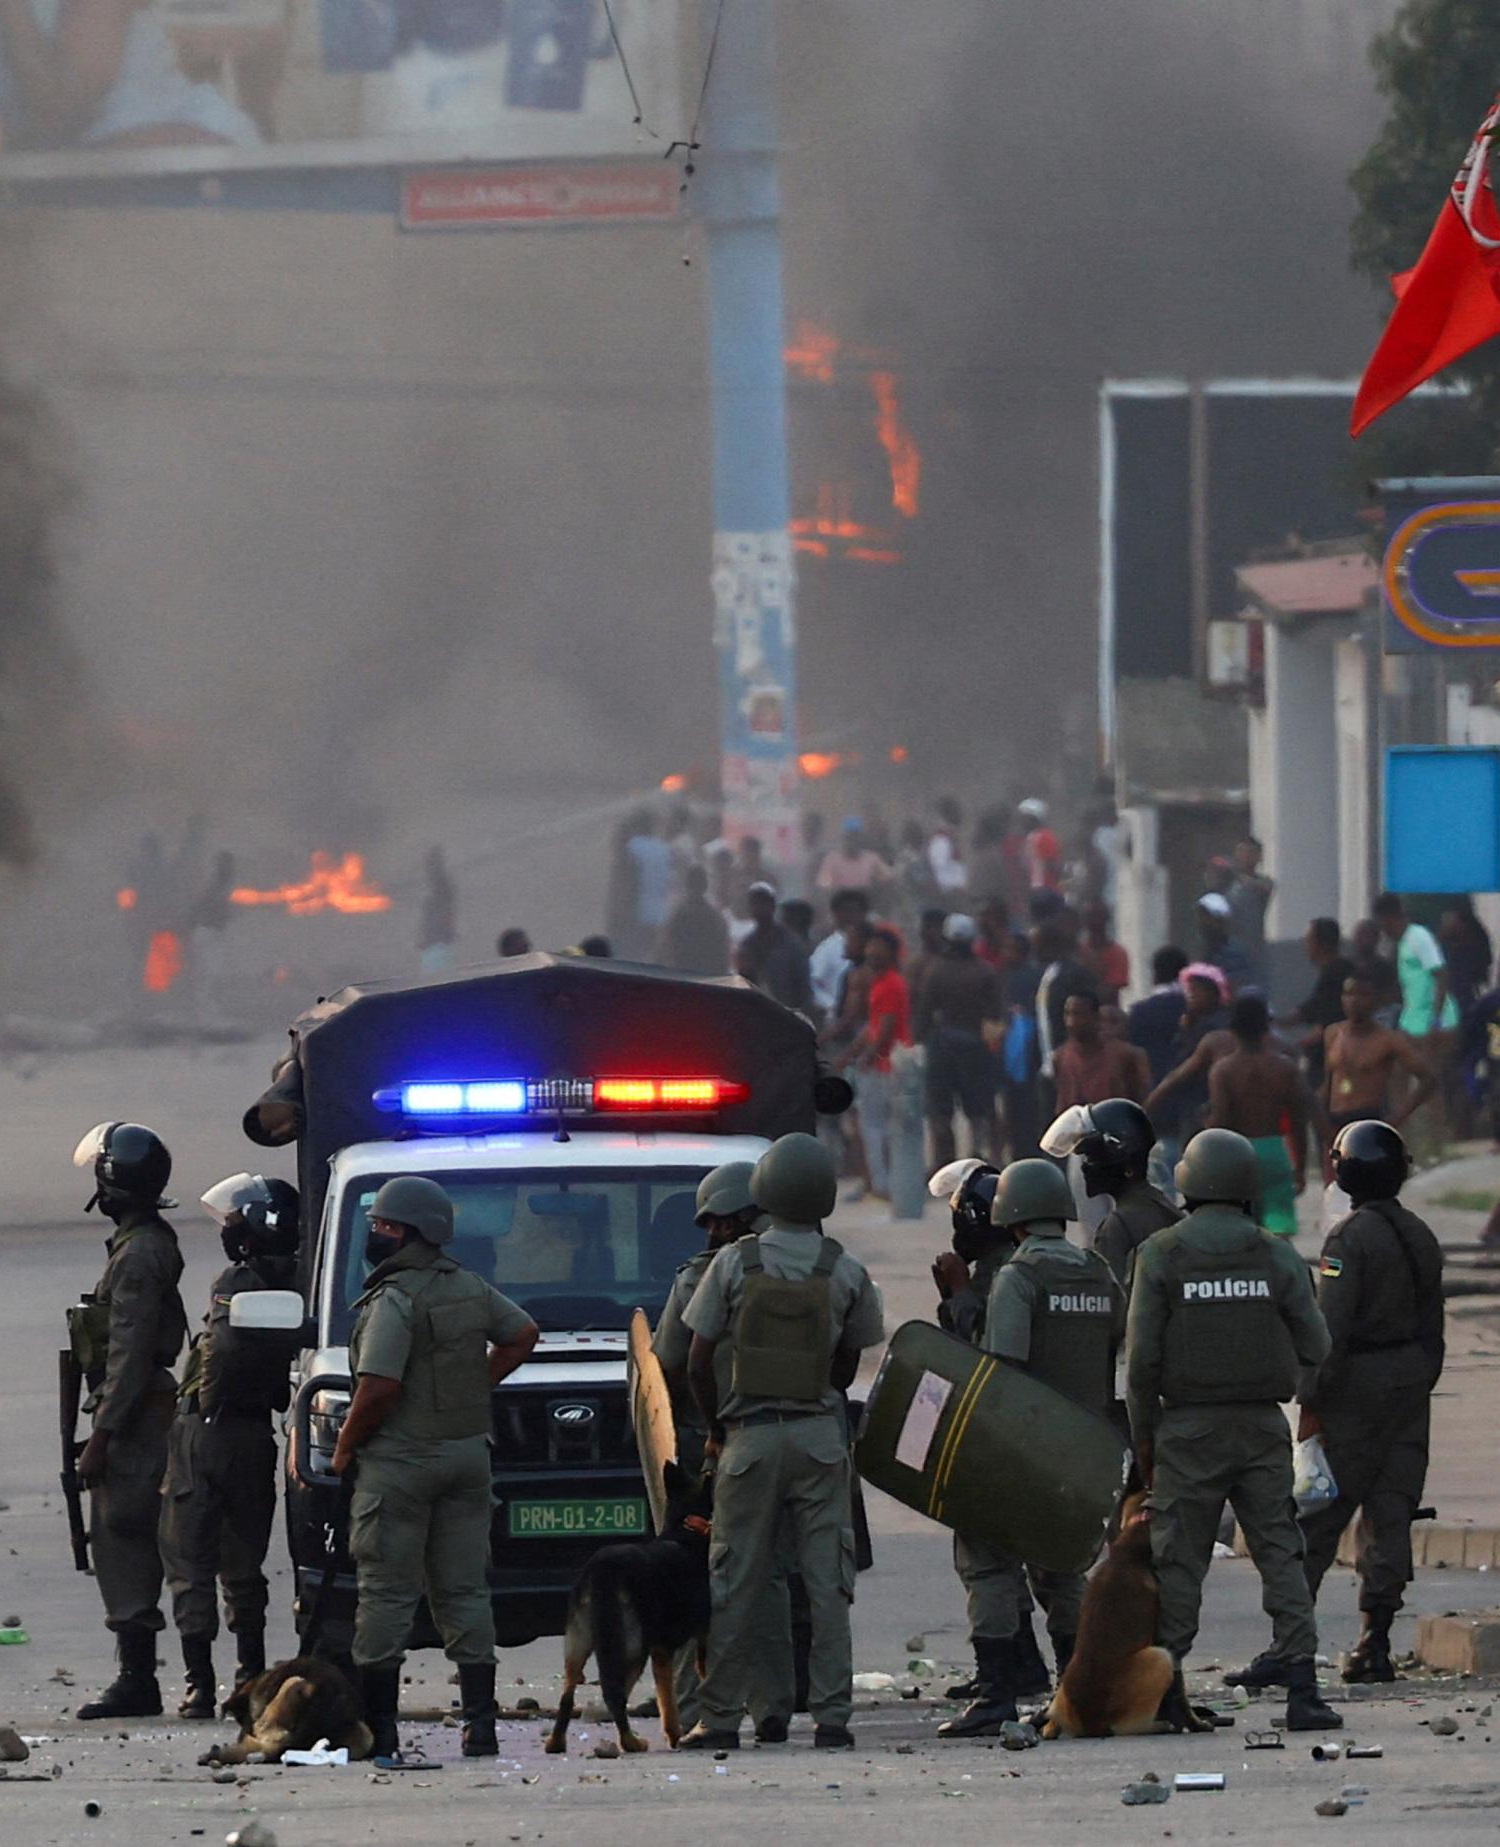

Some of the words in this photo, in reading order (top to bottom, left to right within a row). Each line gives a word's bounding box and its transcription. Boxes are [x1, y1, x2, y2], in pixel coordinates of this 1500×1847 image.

[1183, 1278, 1270, 1299] POLÍCIA
[1049, 1293, 1111, 1312] POLÍCIA
[520, 1505, 636, 1529] PRM-01-2-08
